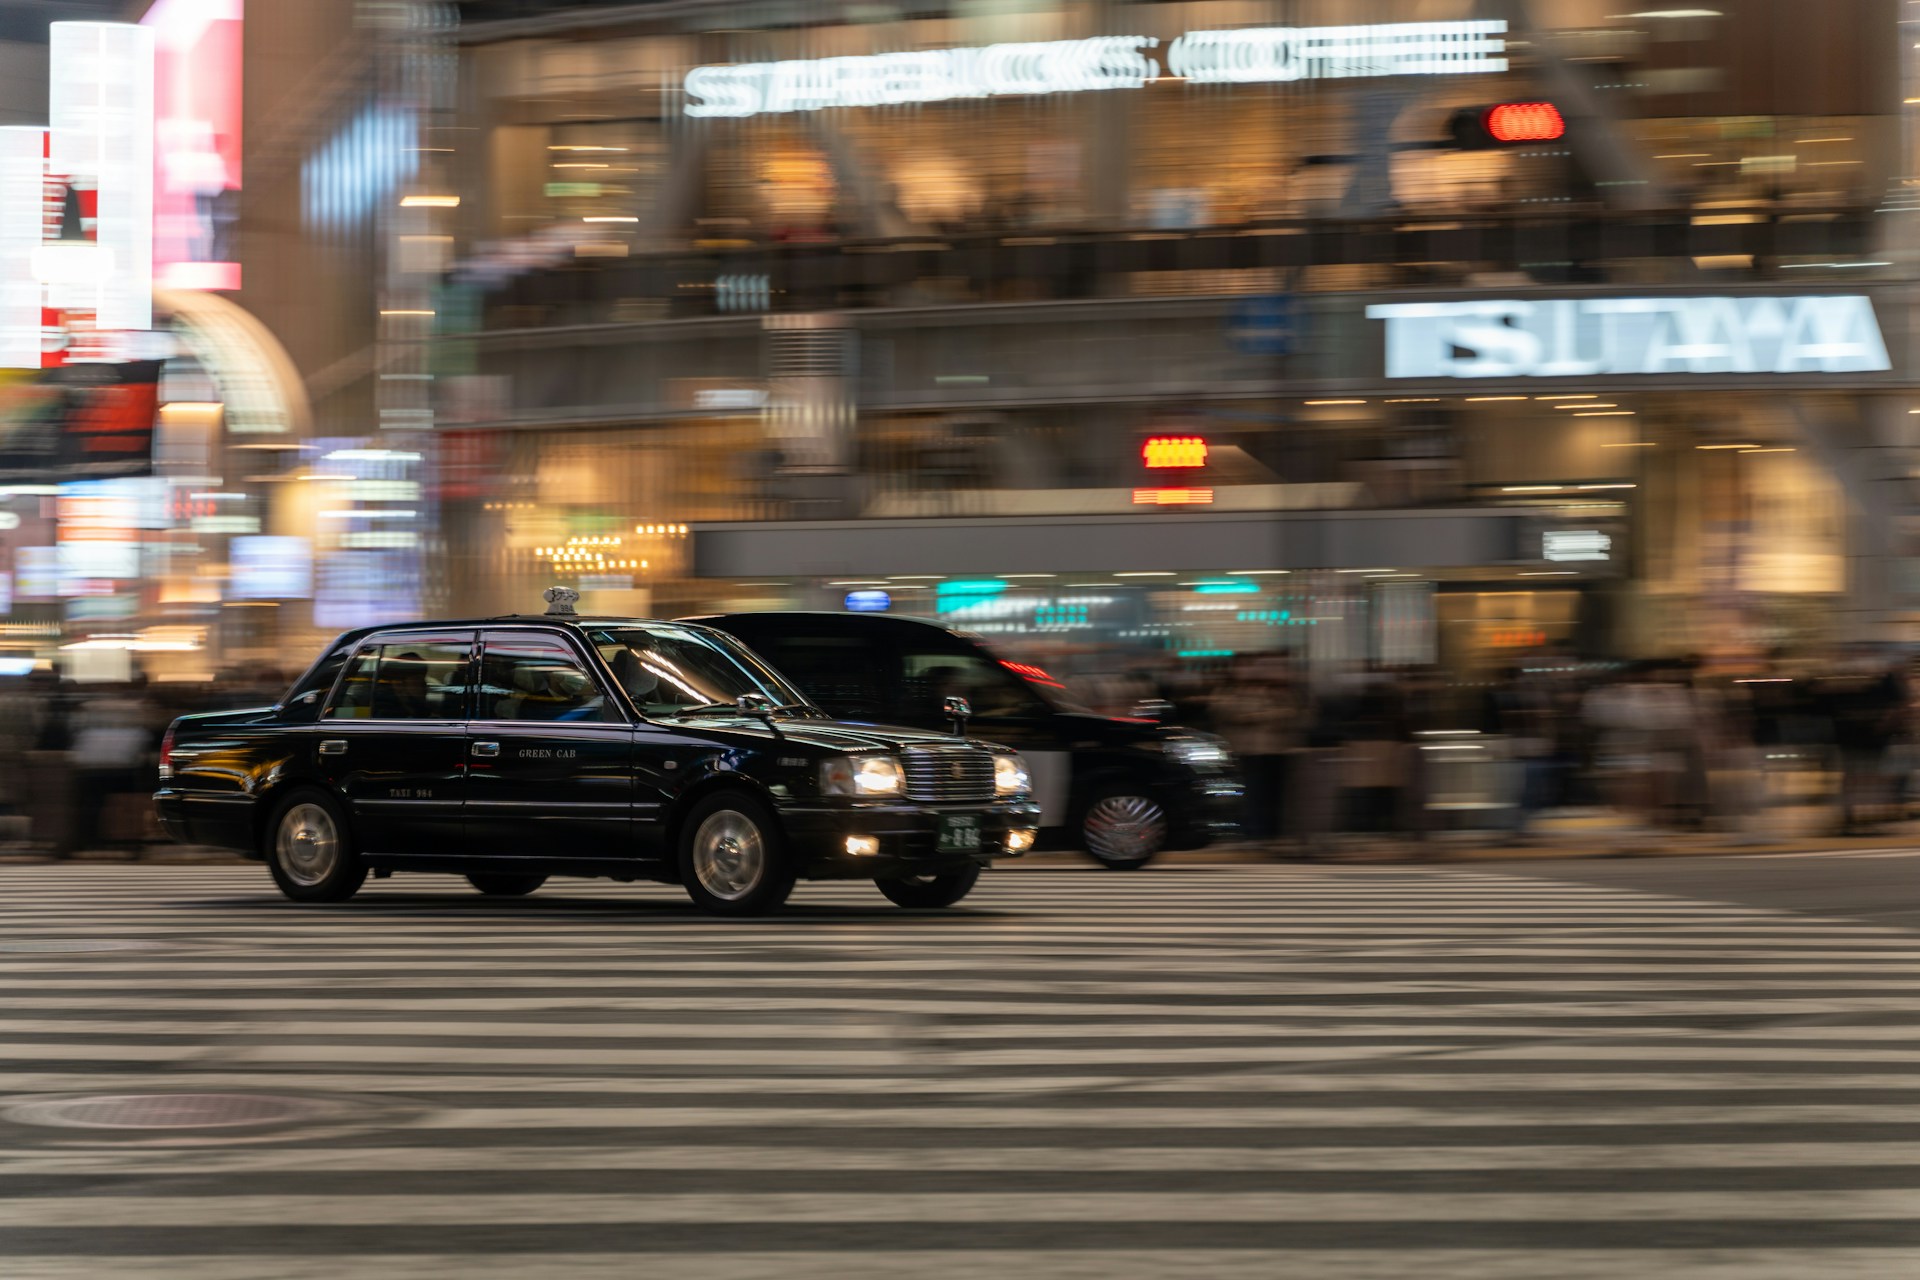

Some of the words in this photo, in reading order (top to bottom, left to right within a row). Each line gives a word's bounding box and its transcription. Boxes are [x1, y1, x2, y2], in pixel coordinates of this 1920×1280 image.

[518, 749, 552, 758] GREEN
[556, 749, 576, 758] CAB
[389, 788, 411, 798] TAXI
[416, 788, 432, 798] 984
